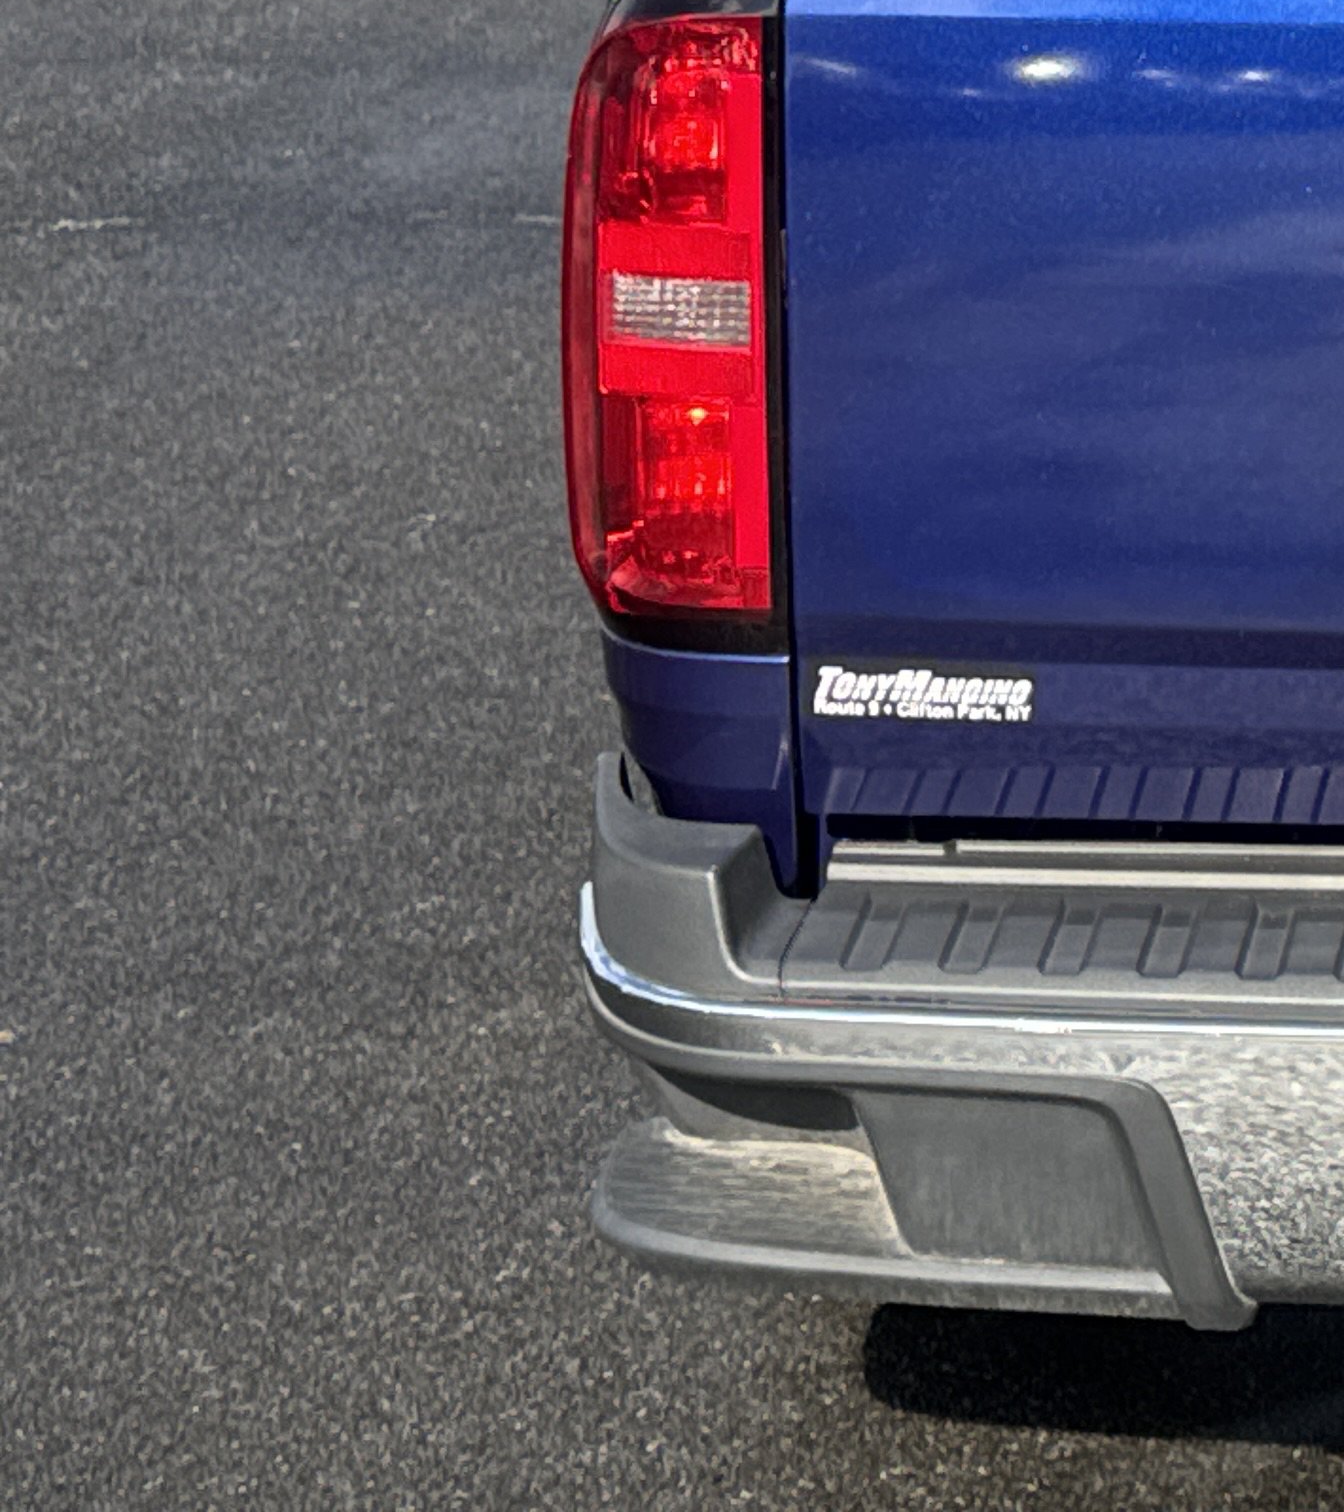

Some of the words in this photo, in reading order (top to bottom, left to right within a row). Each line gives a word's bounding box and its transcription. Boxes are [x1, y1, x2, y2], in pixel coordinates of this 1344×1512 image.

[814, 699, 866, 717] Route
[868, 700, 880, 717] 9
[896, 700, 954, 719] Clifton
[1005, 704, 1032, 721] NY
